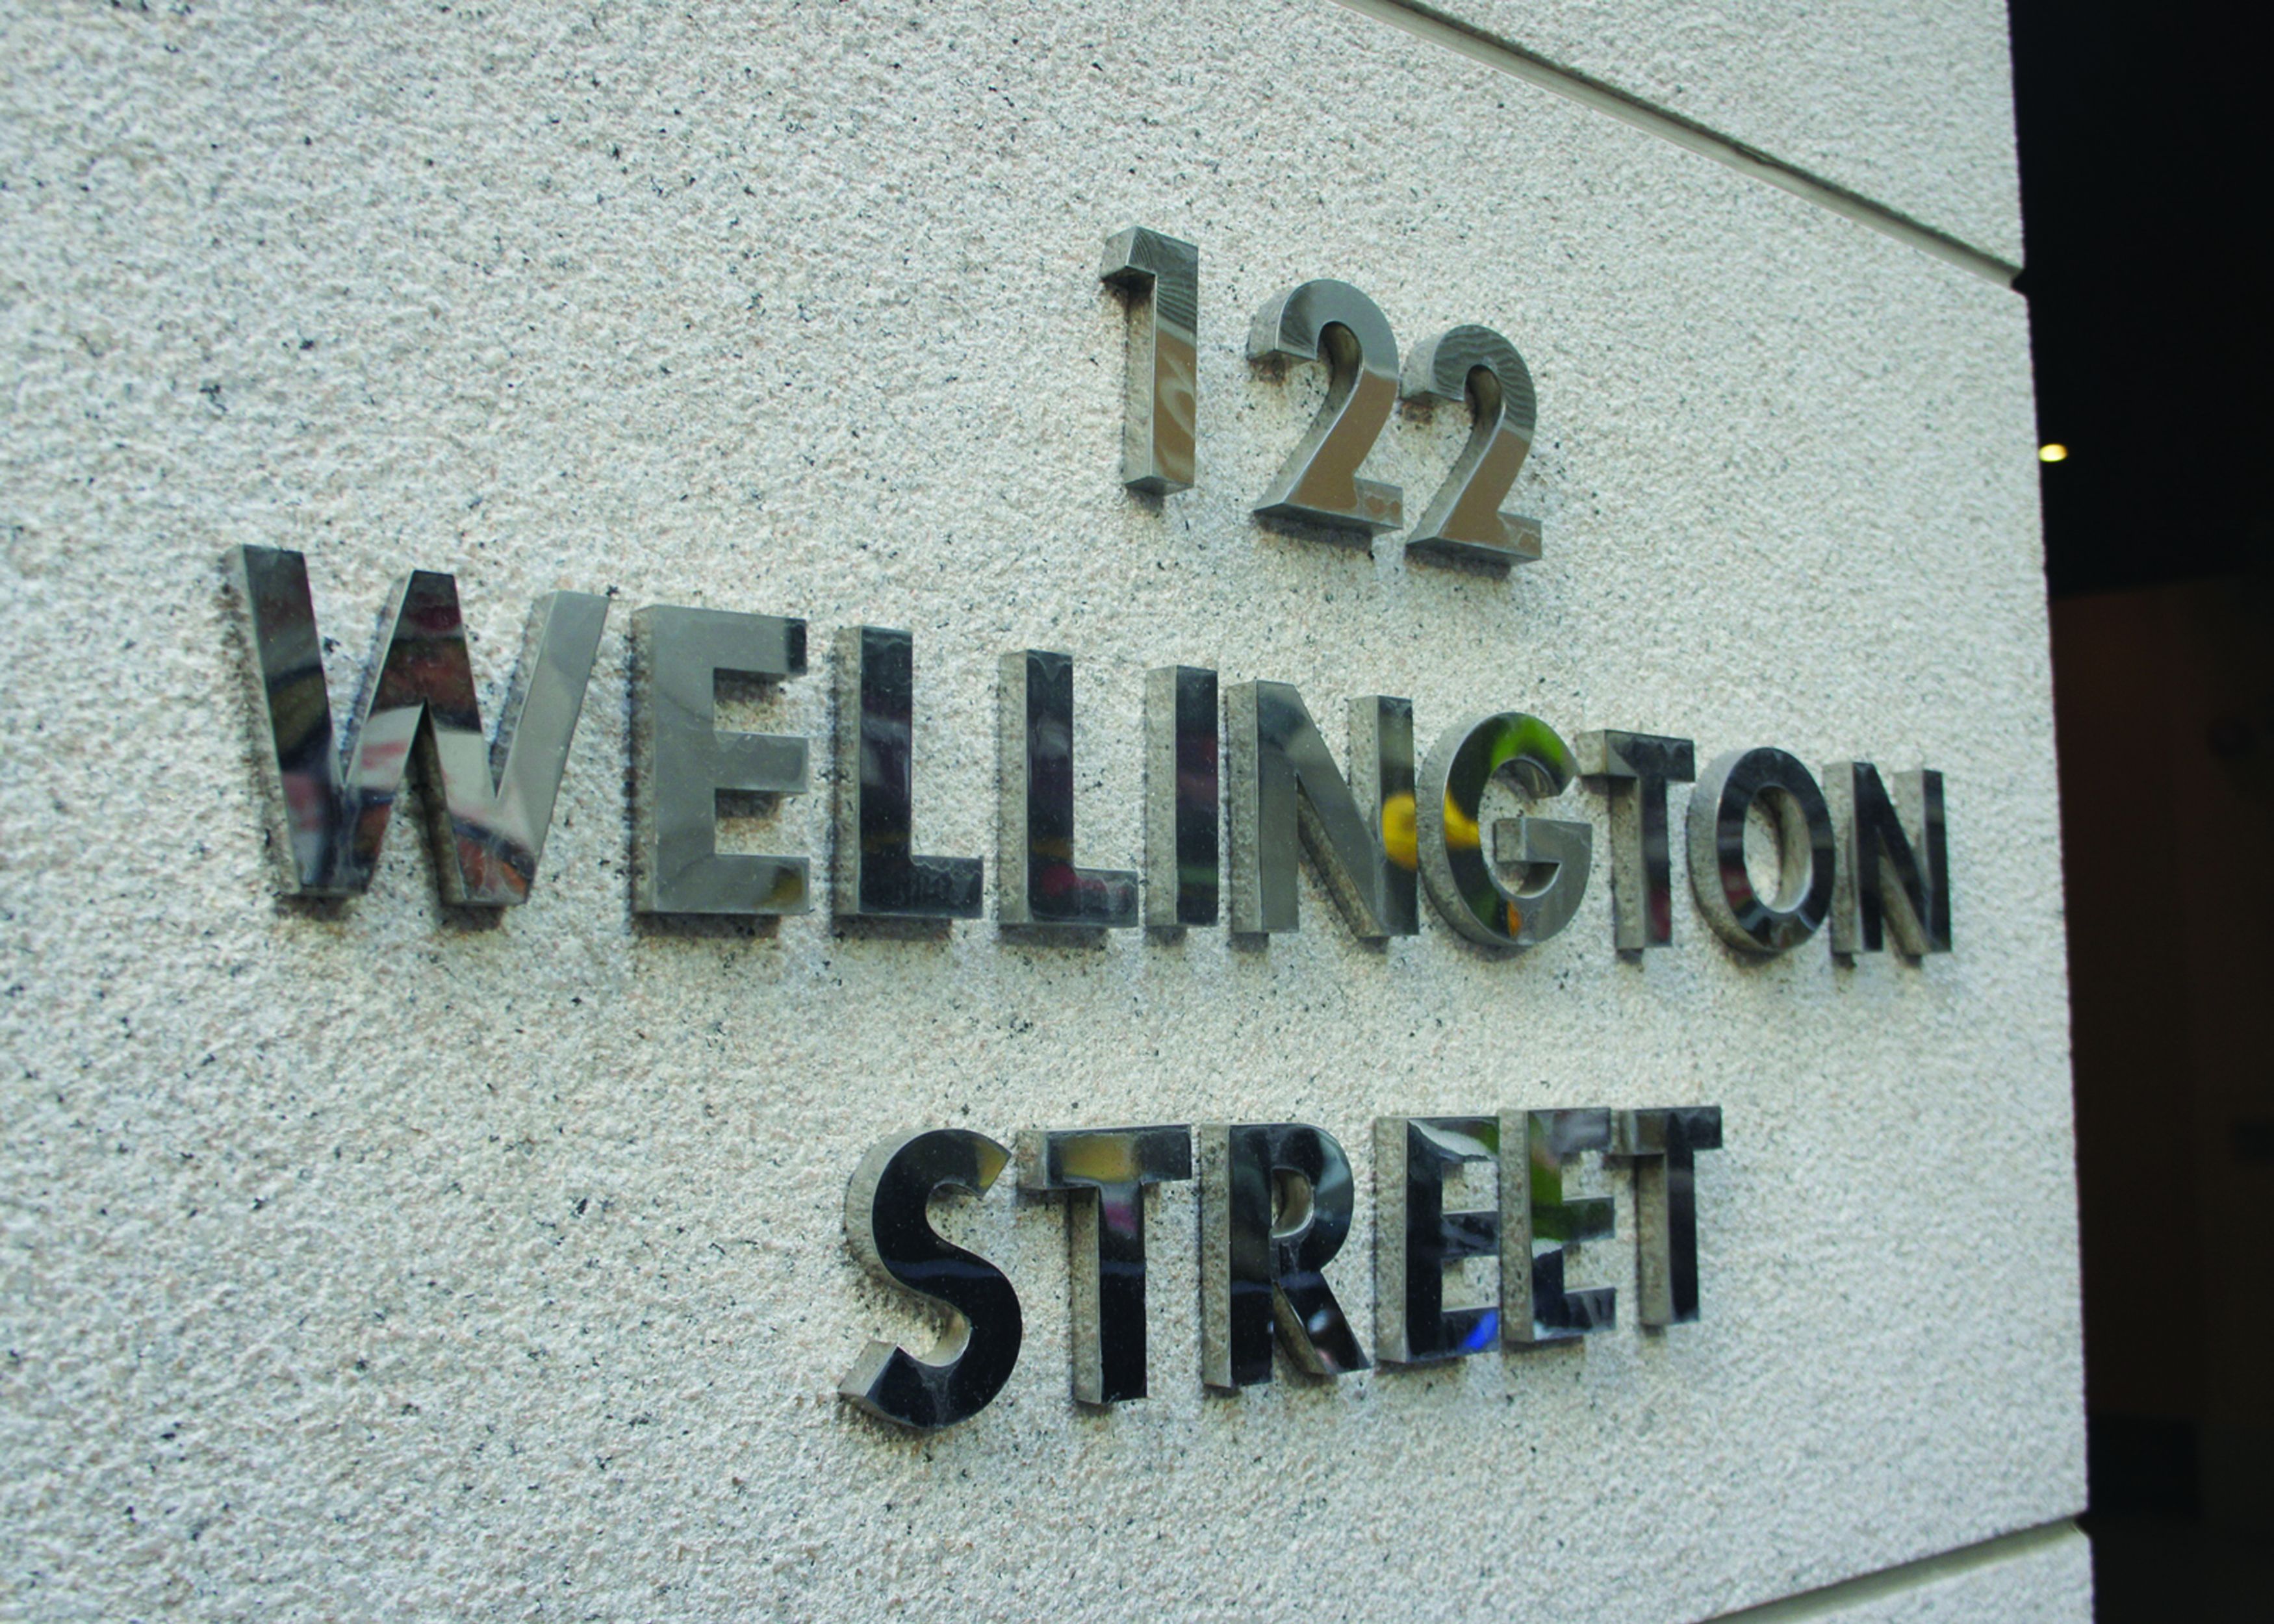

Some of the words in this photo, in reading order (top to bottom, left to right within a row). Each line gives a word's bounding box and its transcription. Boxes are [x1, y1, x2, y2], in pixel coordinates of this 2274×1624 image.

[1103, 229, 1542, 564] 122
[225, 544, 1952, 954] WELLINGTON
[840, 1106, 1723, 1429] STREET
